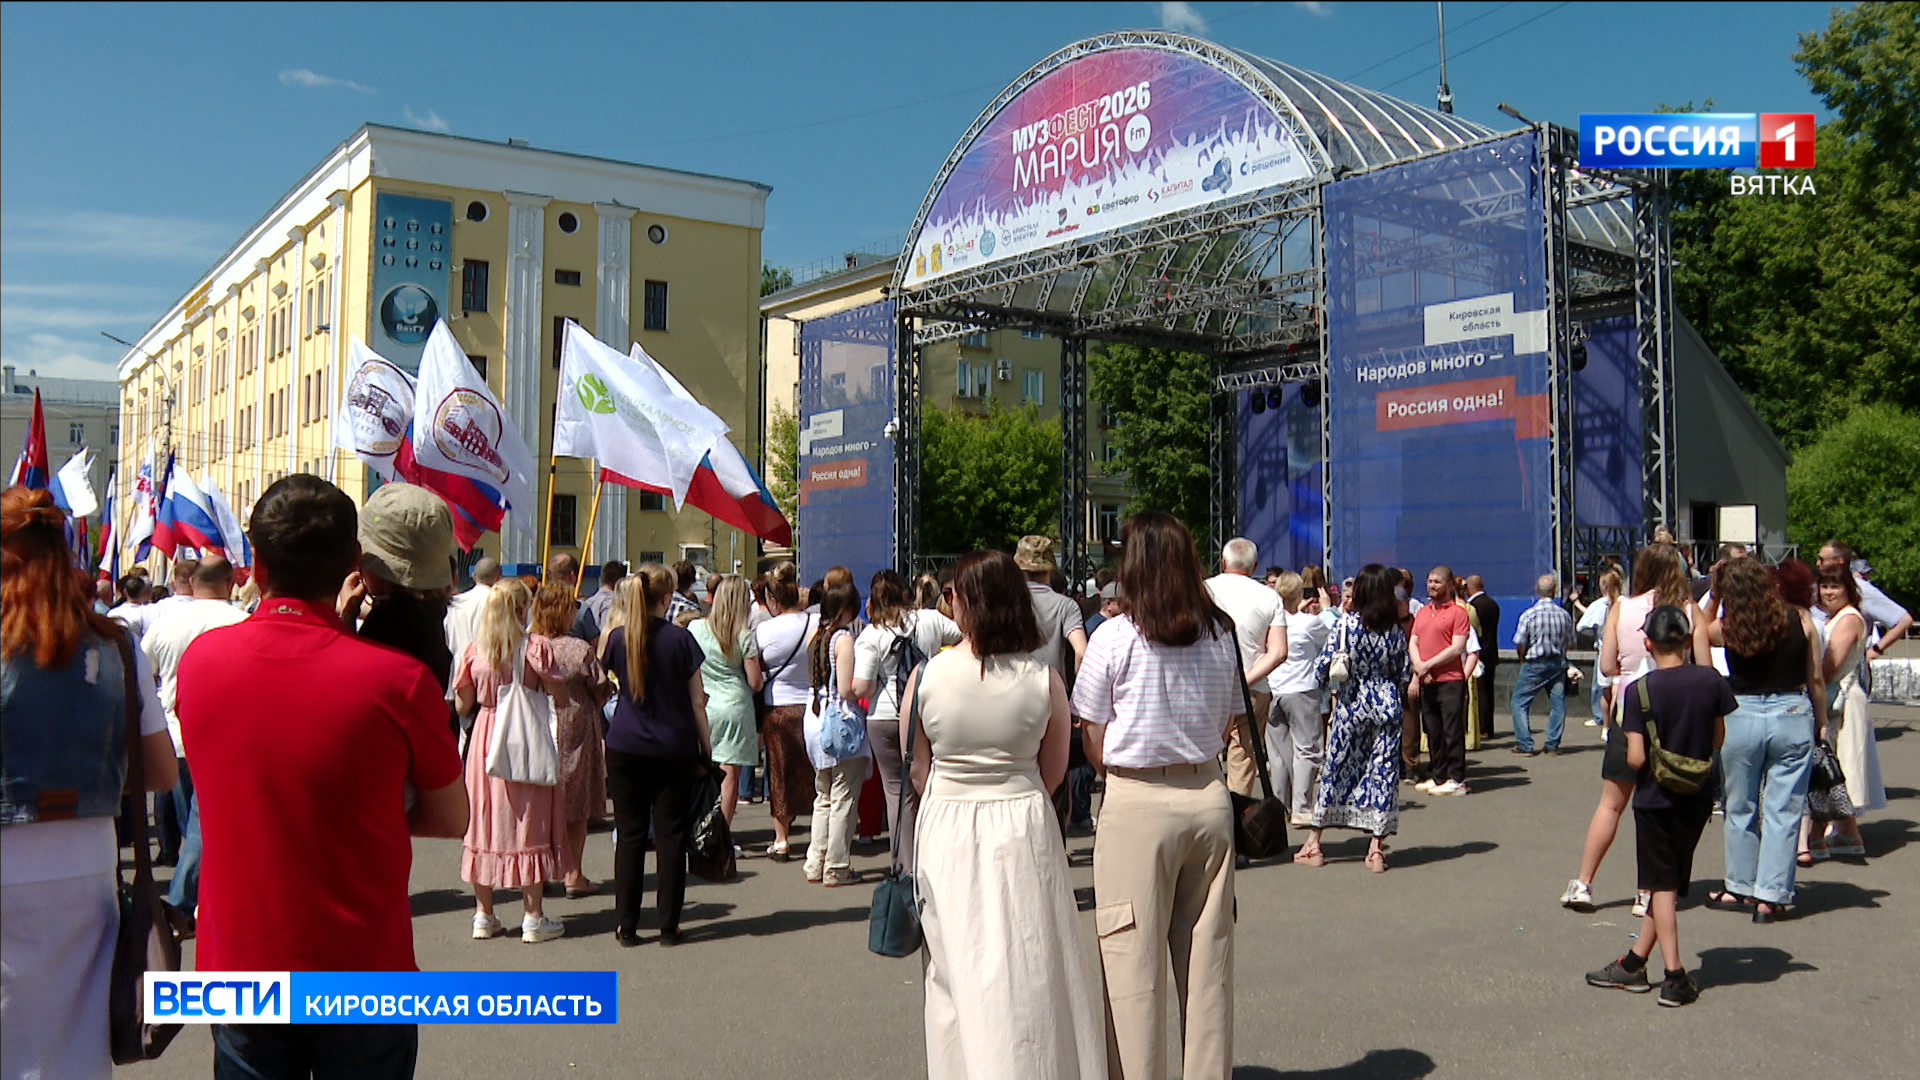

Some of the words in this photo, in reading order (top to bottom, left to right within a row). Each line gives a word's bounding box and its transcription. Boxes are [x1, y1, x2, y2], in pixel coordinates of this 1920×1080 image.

[1013, 123, 1120, 192] МАРИЯ
[1449, 306, 1501, 322] Кировская
[1462, 320, 1501, 332] область
[1357, 361, 1427, 383] Народов
[1430, 353, 1485, 371] много
[1387, 398, 1448, 418] Россия
[1453, 389, 1504, 412] одна!
